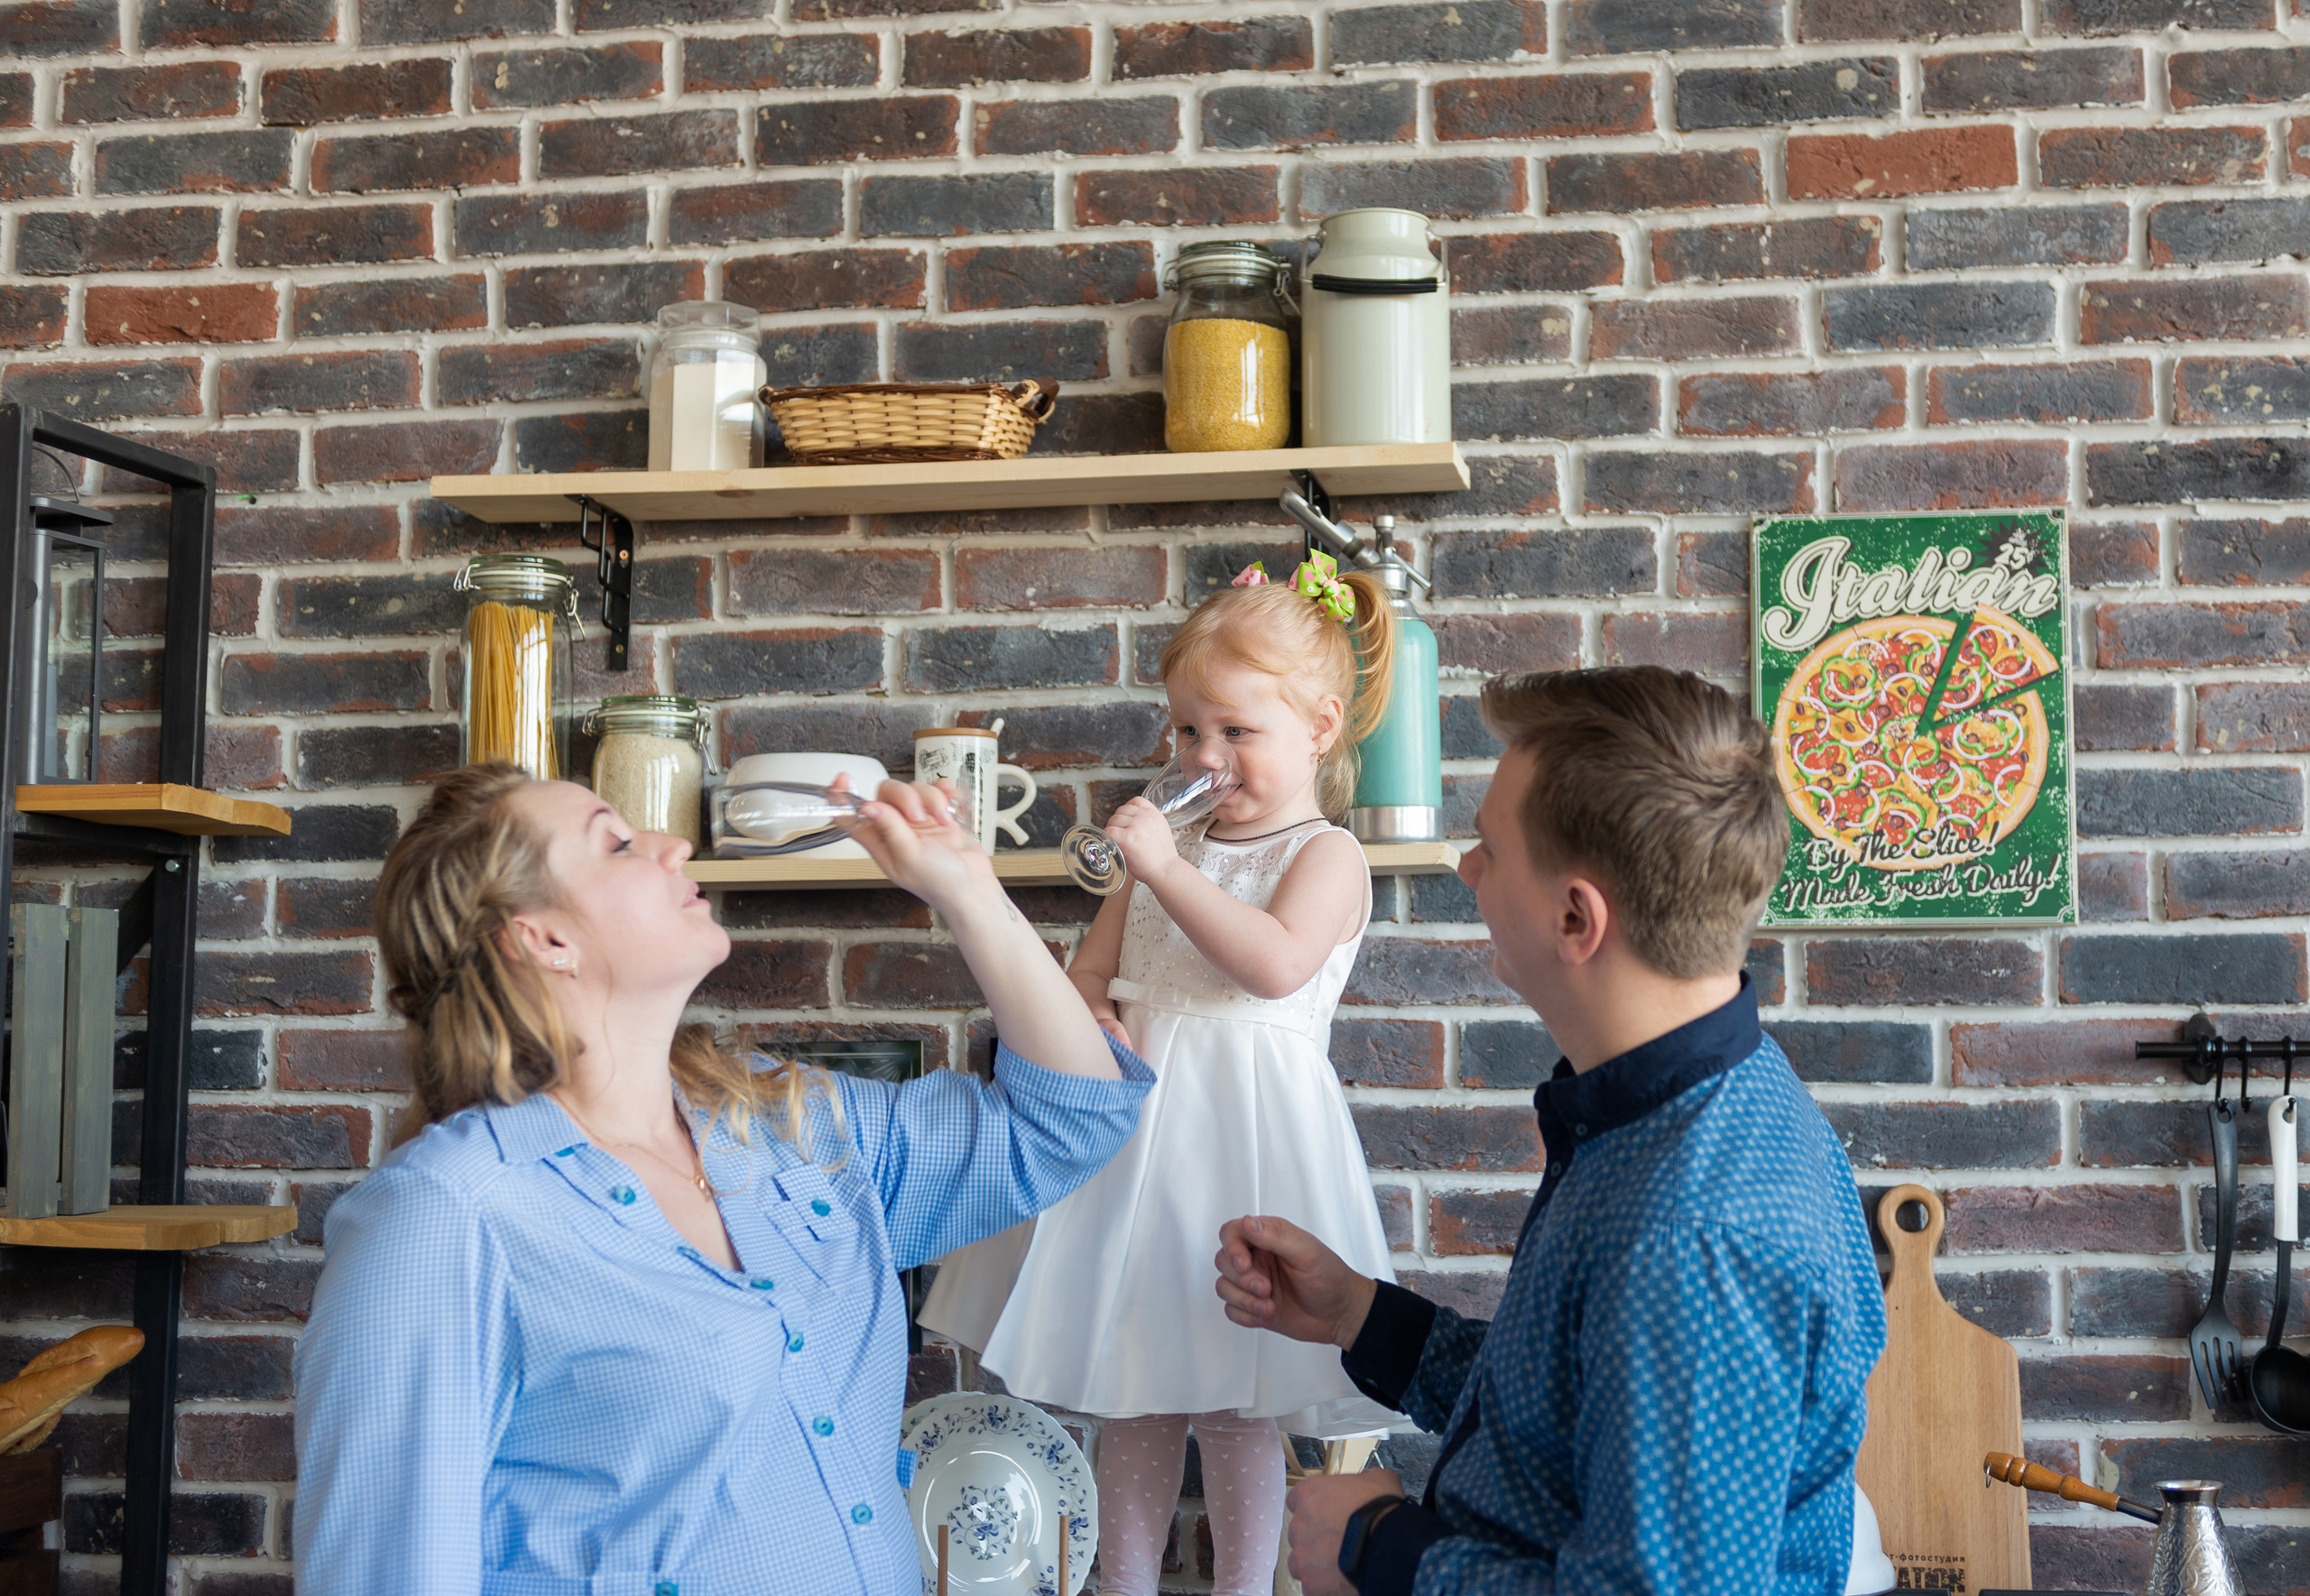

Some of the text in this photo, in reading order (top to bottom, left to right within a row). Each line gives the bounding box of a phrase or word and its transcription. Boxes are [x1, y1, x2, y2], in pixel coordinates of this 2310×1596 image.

[1762, 536, 2059, 650] Italian
[1804, 820, 2000, 883] By The Slice!
[1780, 853, 2062, 912] Made Fresh Daily!
[1883, 1551, 1965, 1564] т-фотостудия
[1893, 1565, 1965, 1593] ATION
